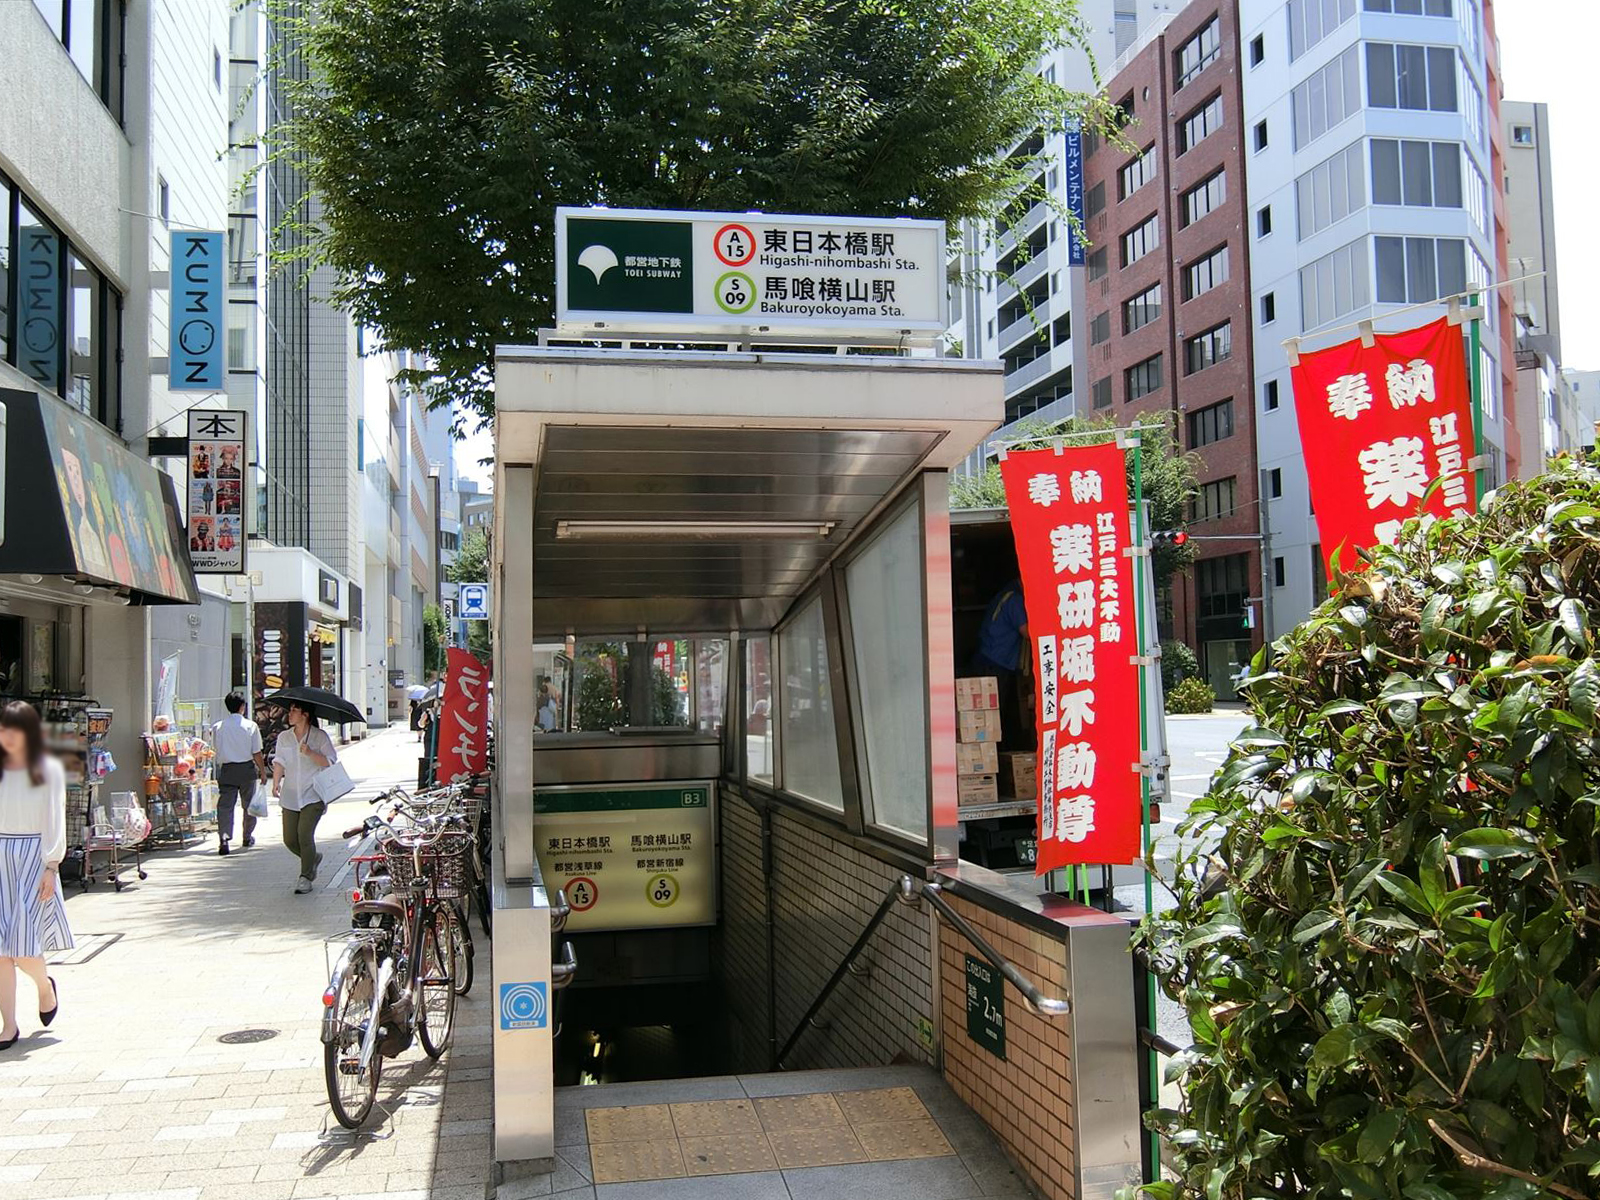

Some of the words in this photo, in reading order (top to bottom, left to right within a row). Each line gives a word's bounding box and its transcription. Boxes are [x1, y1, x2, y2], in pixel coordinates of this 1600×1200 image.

[730, 231, 741, 244] A
[763, 229, 895, 257] 東日本橋駅
[726, 244, 745, 258] 15
[624, 256, 682, 269] 都営地下鉄
[760, 254, 891, 270] Higashi-nihombashi
[896, 257, 920, 270] Sta.
[624, 269, 644, 278] TOEI
[647, 269, 682, 279] SUBWAY
[731, 278, 740, 291] S
[764, 276, 895, 303] 馬喰横山駅
[725, 291, 745, 305] 09
[179, 238, 214, 382] KUMON
[760, 302, 876, 317] Bakuroyokoyama
[881, 304, 905, 317] Sta.
[1326, 358, 1436, 421] 奉納
[197, 414, 236, 438] 本
[1028, 470, 1102, 507] 奉納
[191, 560, 239, 568] WWDジャパン
[1096, 512, 1121, 643] 江戸三大不動
[1042, 644, 1056, 716] 工事安全
[1049, 523, 1096, 843] 薬研堀不動尊
[684, 793, 700, 805] B3
[548, 836, 611, 850] 東日本橋駅
[630, 833, 692, 847] 馬喰横山駅
[554, 861, 603, 873] 都営浅草線
[636, 858, 684, 869] 都営新宿線
[576, 883, 586, 893] A
[659, 879, 666, 889] S
[573, 893, 589, 904] 15
[654, 889, 671, 901] 09
